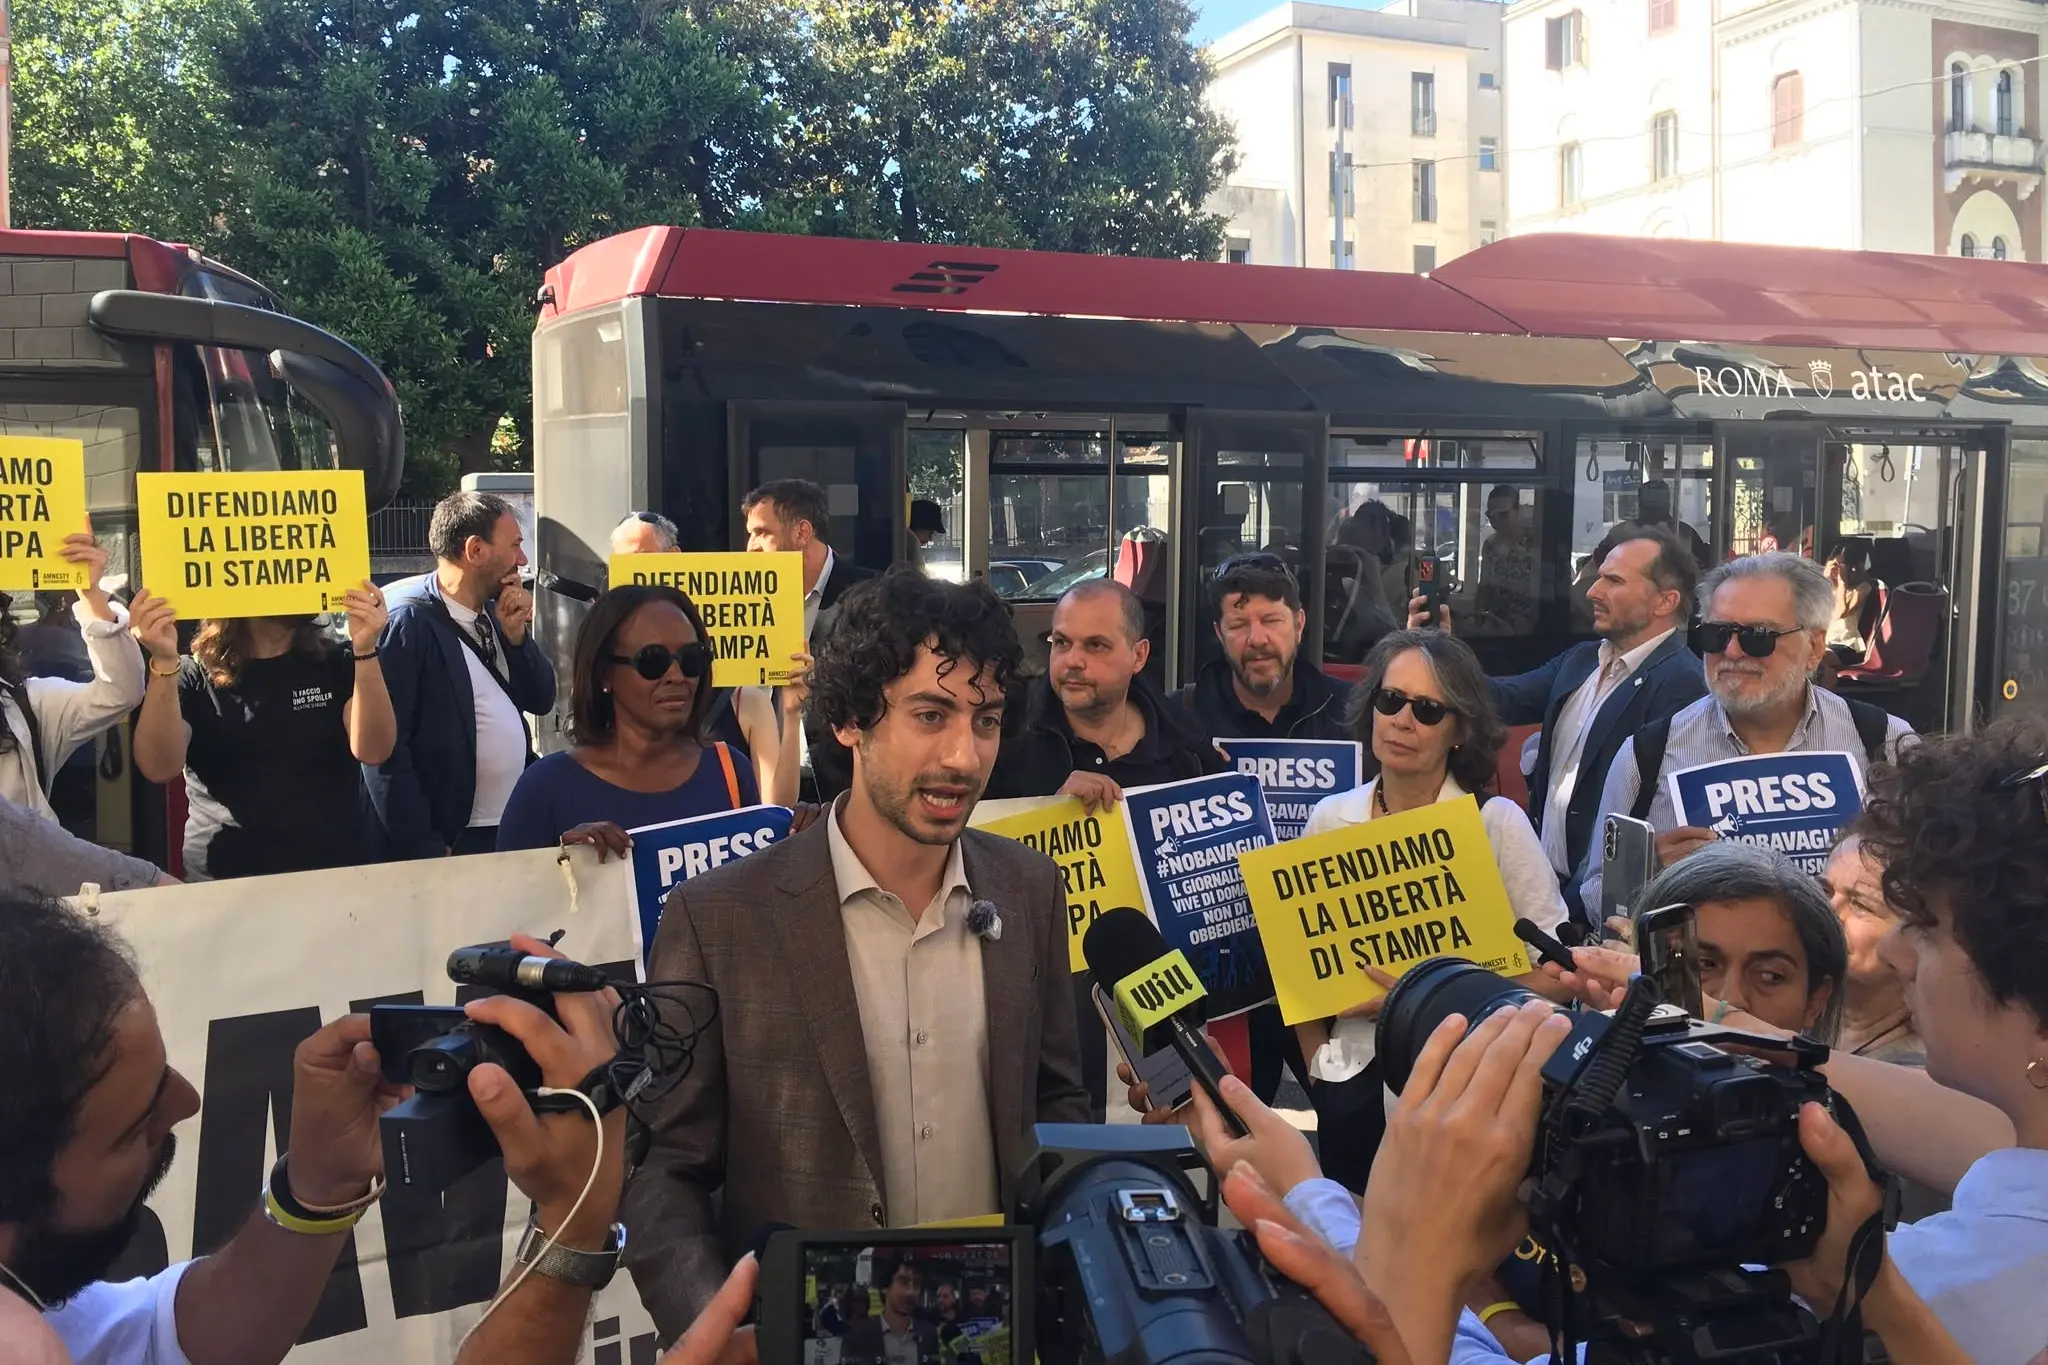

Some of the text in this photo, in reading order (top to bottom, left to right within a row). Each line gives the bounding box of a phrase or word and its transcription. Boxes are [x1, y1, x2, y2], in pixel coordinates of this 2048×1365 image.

[1695, 366, 1795, 399] ROMA
[1850, 365, 1927, 402] atac
[167, 488, 337, 519] DIFENDIAMO
[183, 517, 336, 553] LA LIBERTÀ
[185, 556, 331, 588] DI STAMPA
[708, 634, 770, 660] AMPA
[1237, 757, 1336, 789] PRESS
[1704, 771, 1836, 818] PRESS
[1149, 790, 1253, 841] PRESS
[1060, 851, 1106, 894] RTÀ
[1271, 828, 1456, 901] DIFENDIAMO
[1168, 883, 1182, 898] IL
[1172, 883, 1248, 913] VIVE DI DOMA
[1297, 864, 1467, 938] LA LIBERTÀ
[1067, 900, 1103, 936] PA
[1189, 914, 1257, 945] OBBEDIENZ
[1203, 901, 1248, 925] NON DI
[1309, 915, 1473, 980] DI STAMPA
